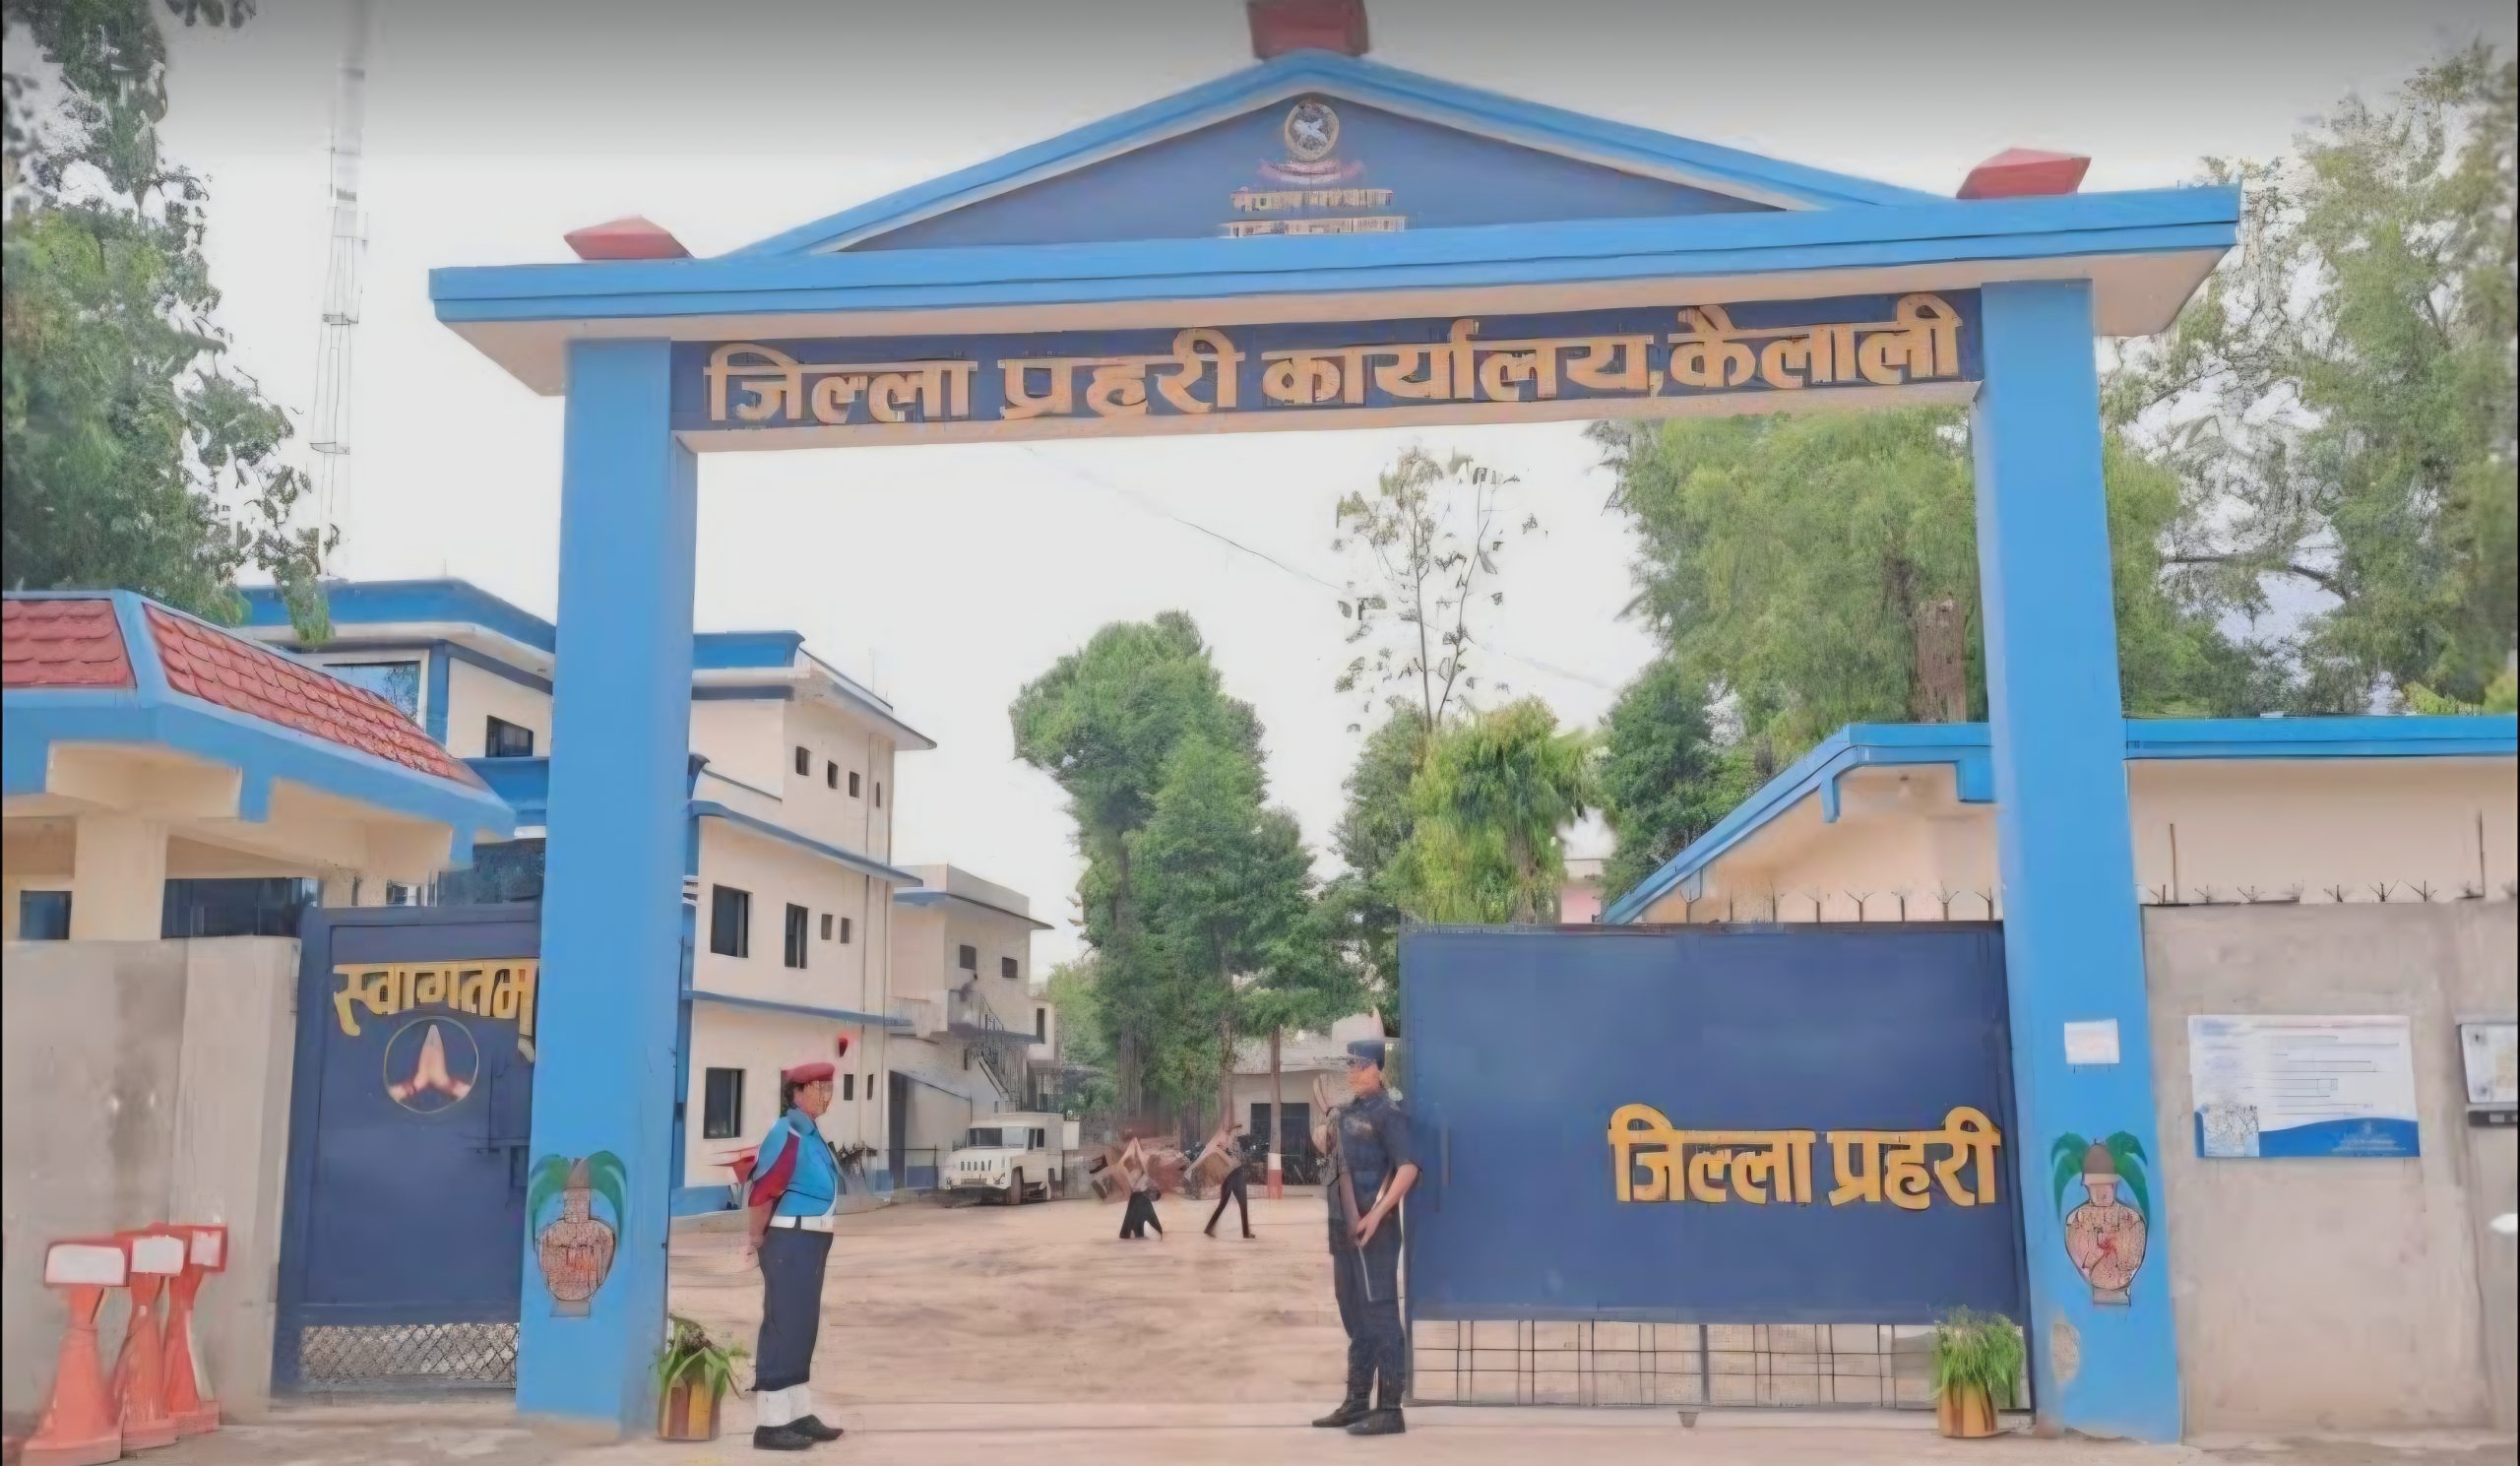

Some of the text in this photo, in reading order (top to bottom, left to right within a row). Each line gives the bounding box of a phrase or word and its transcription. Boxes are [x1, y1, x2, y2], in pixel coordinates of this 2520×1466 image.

[704, 343, 978, 424] जिल्ला
[997, 327, 1246, 420] प्रहरी
[1668, 293, 1962, 390] कैलाली
[1607, 1103, 2002, 1211] जिल्ला प्रहरी
